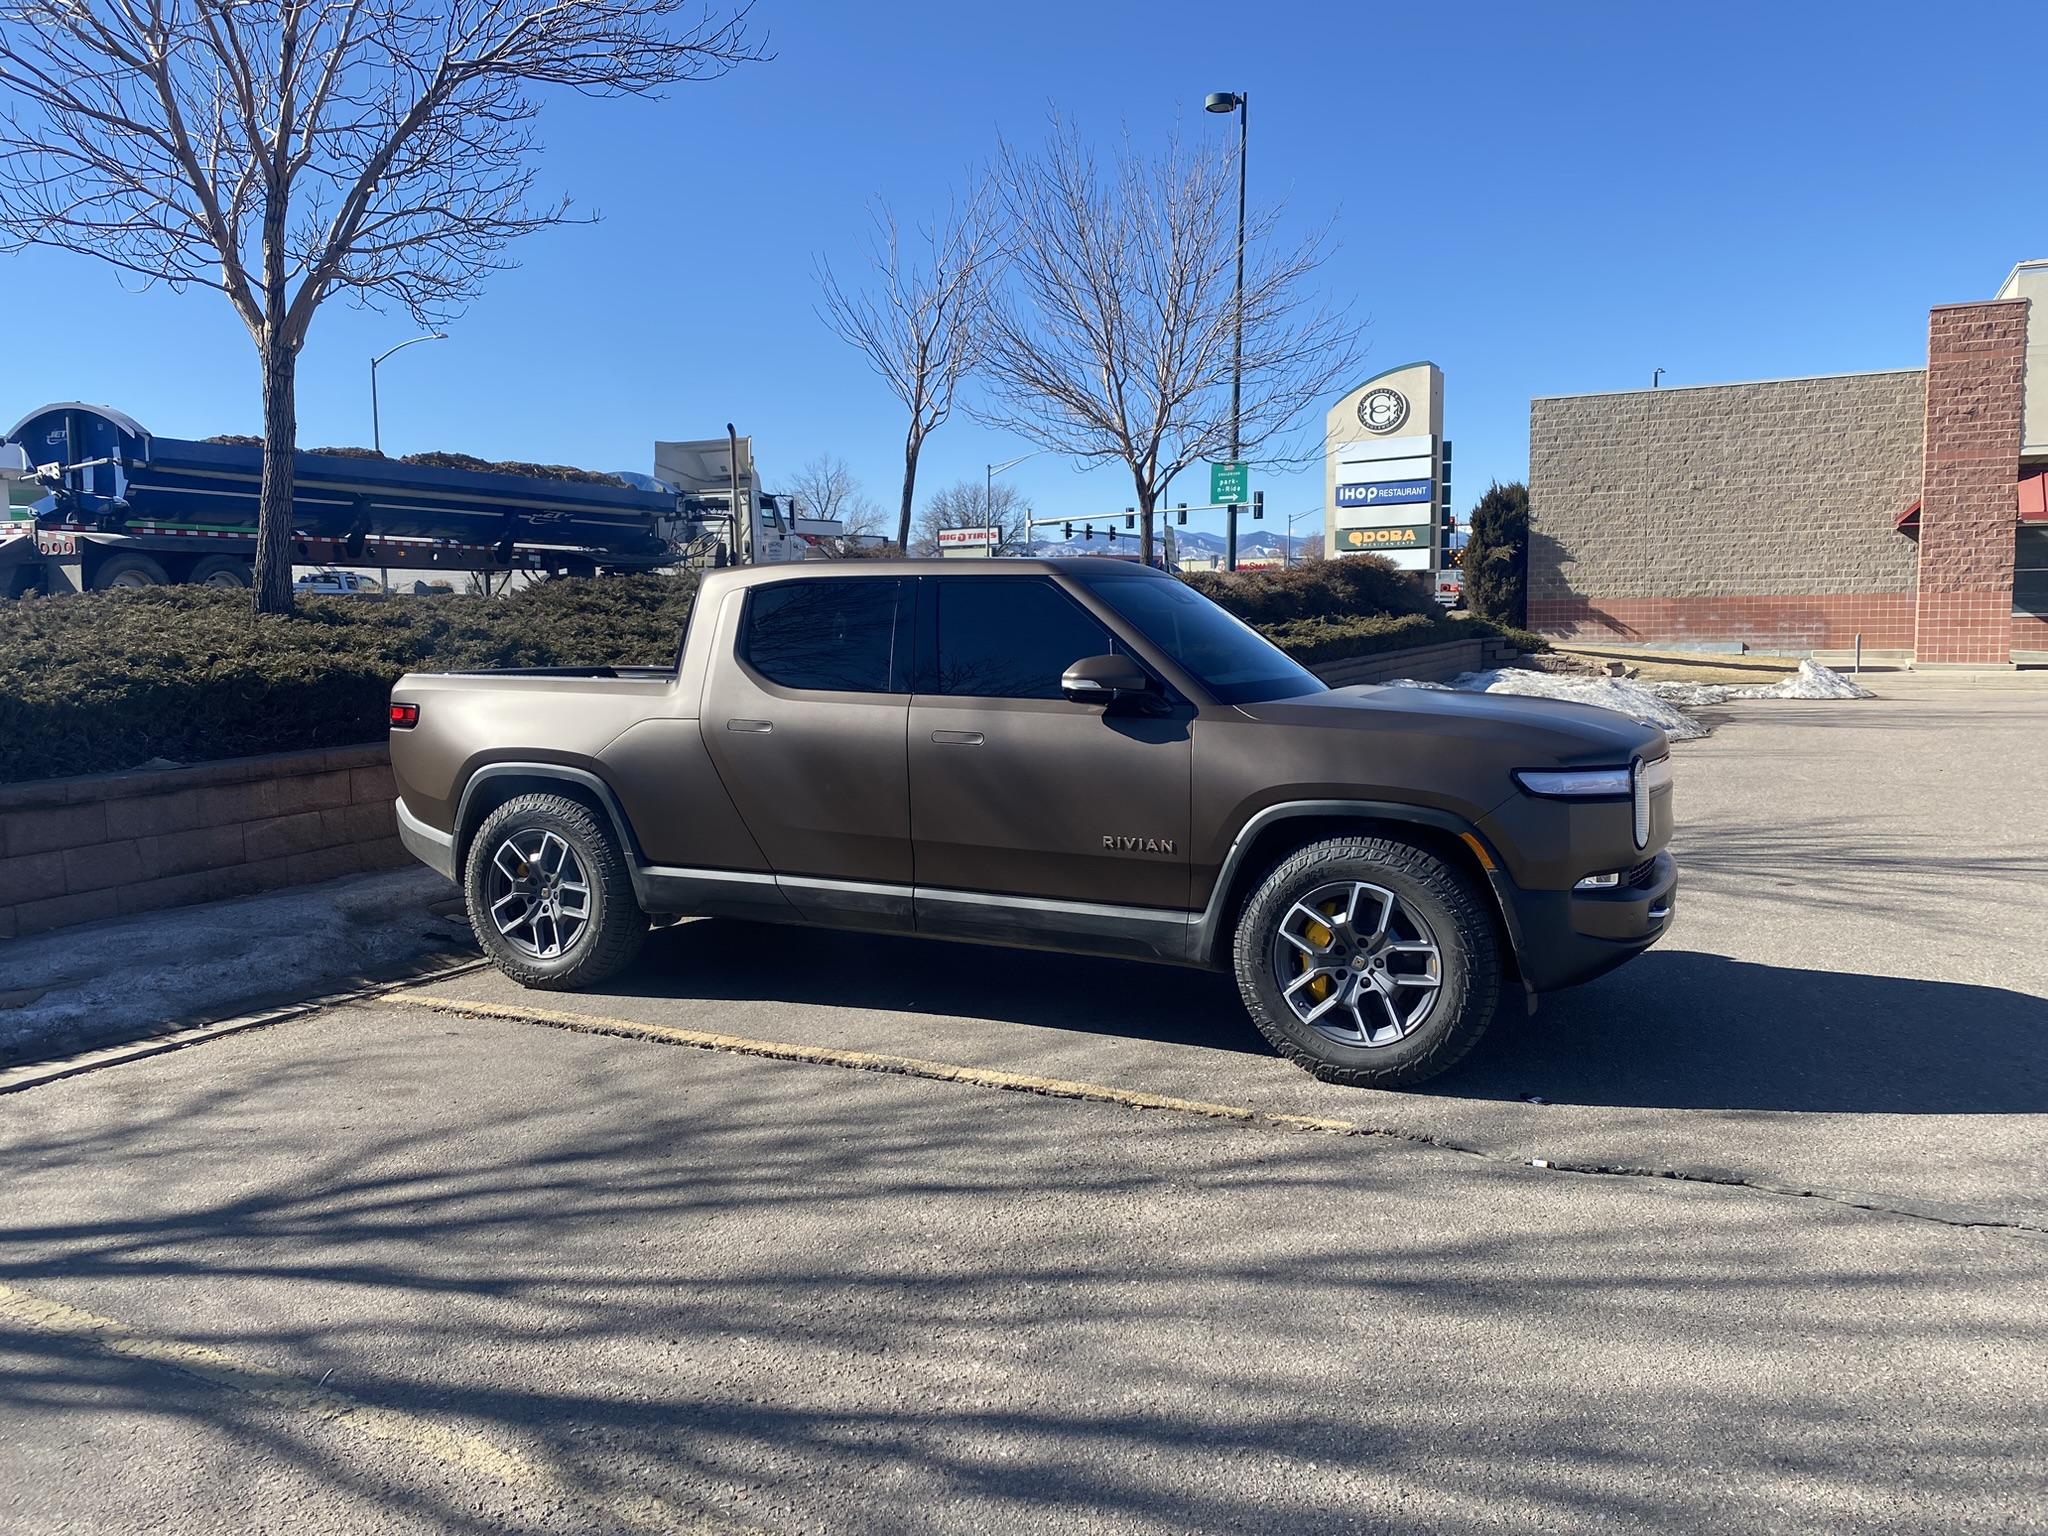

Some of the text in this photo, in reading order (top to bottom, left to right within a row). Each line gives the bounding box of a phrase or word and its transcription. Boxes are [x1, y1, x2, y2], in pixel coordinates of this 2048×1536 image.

[1378, 486, 1427, 497] RESTAURANT
[1348, 529, 1416, 547] QDOBA
[1102, 835, 1174, 853] RIVIAN
